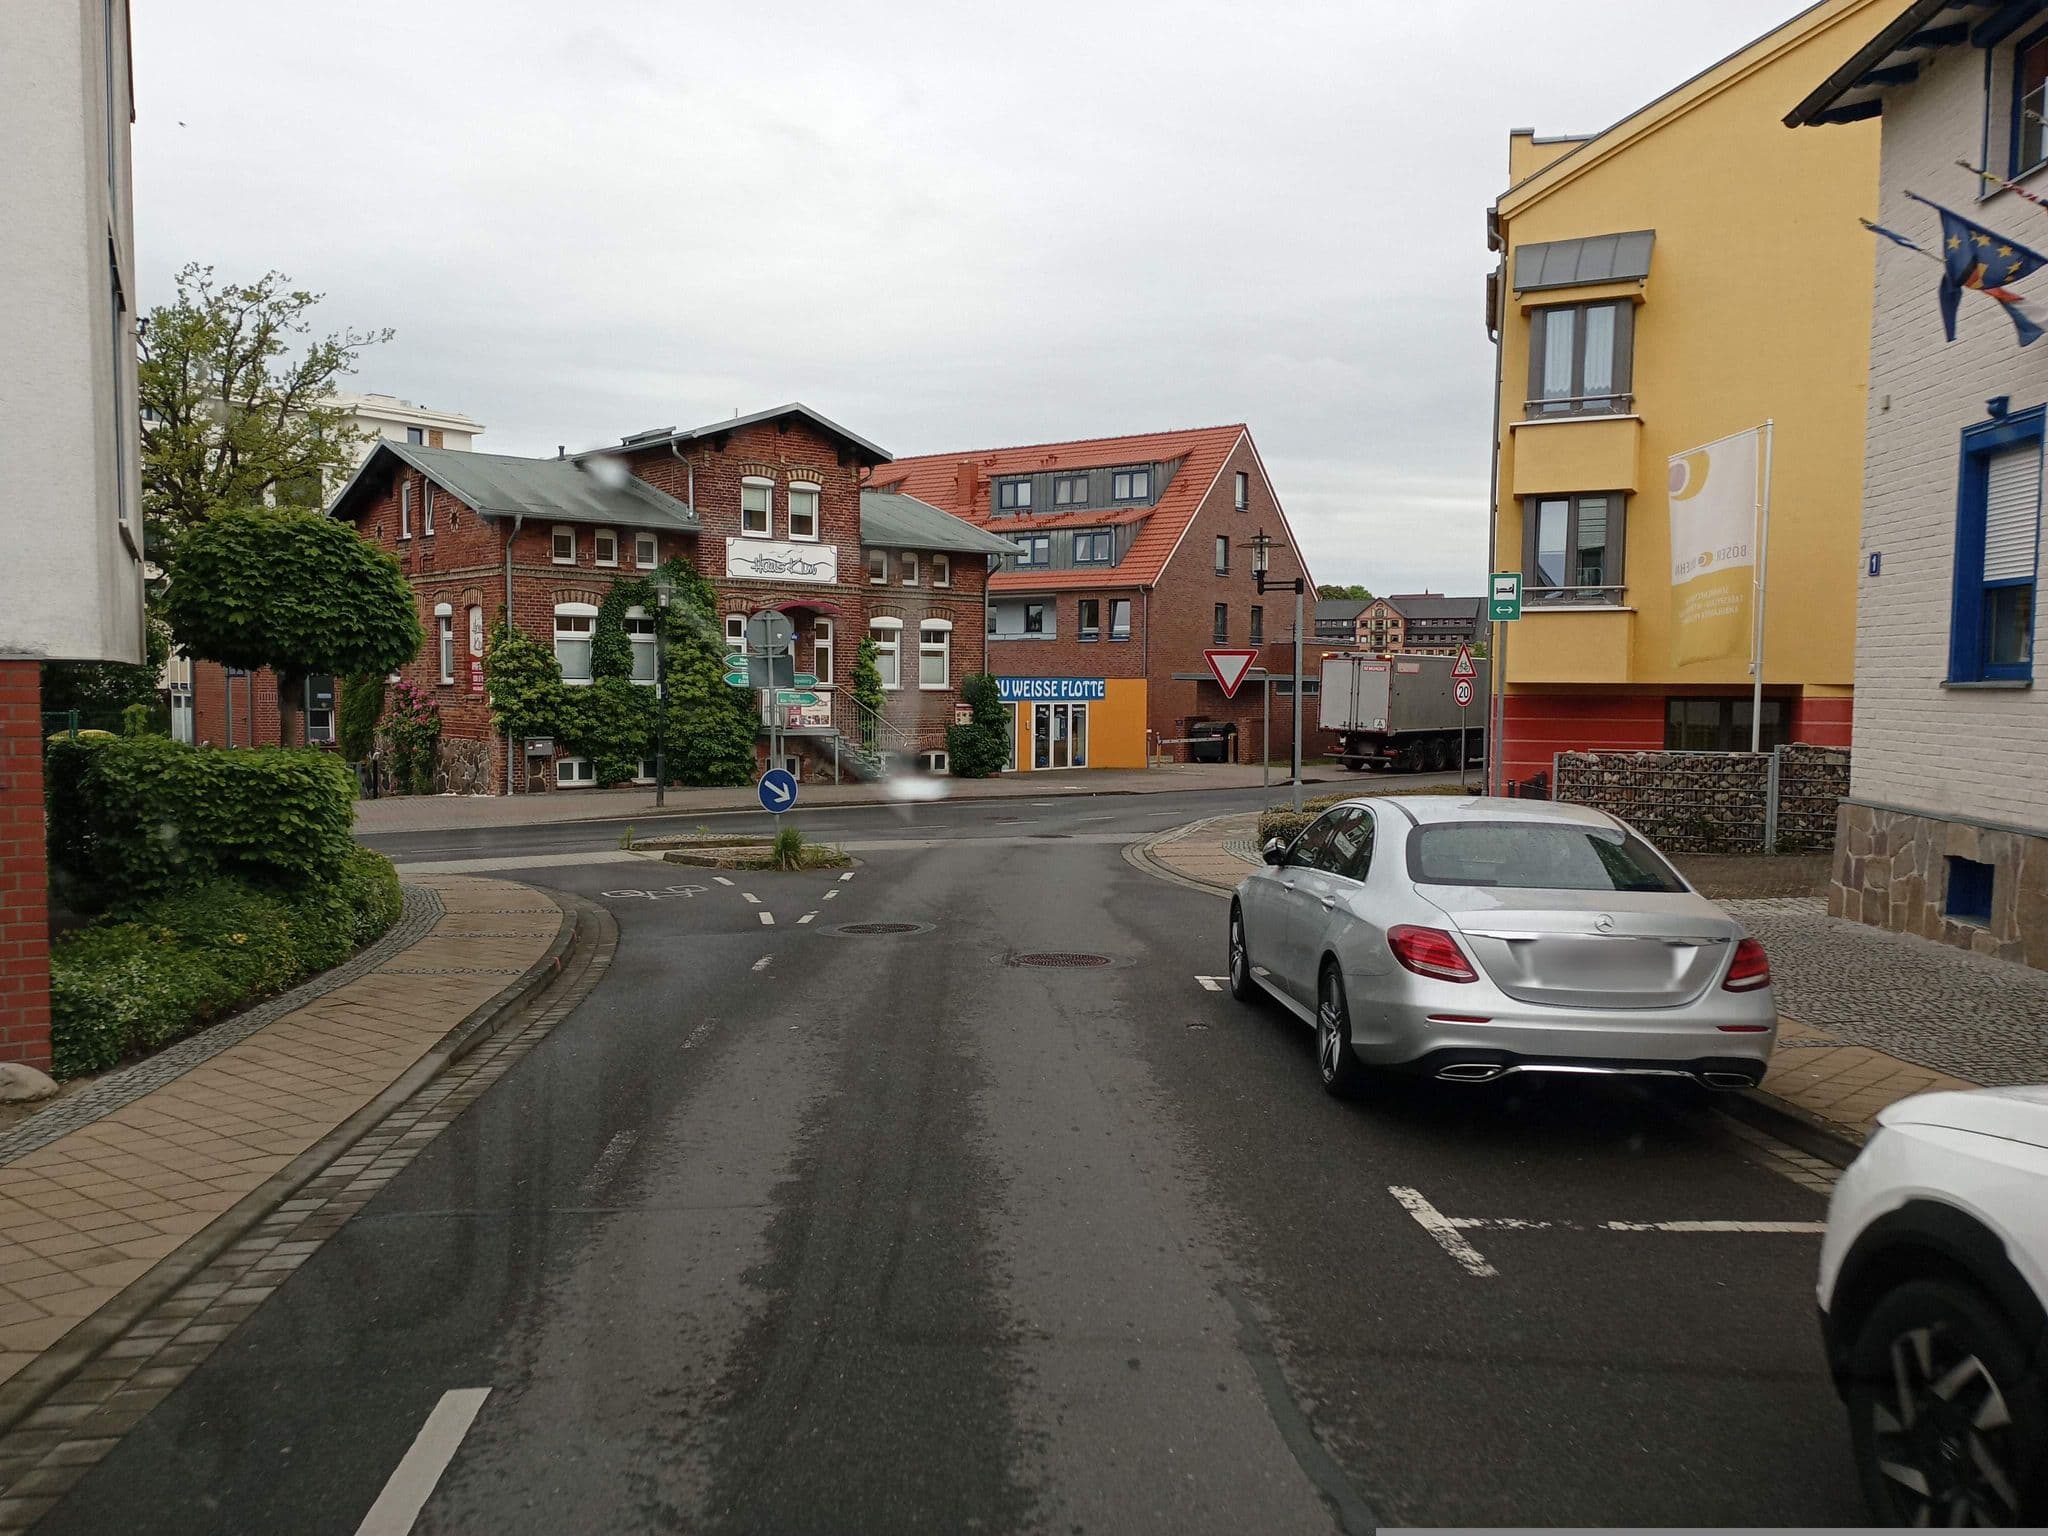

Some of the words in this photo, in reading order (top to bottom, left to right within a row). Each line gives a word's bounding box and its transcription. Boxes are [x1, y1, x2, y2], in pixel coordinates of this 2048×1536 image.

[750, 553, 785, 574] Haus
[1012, 680, 1058, 697] WEISSE
[1061, 680, 1105, 697] FLOTTE
[1458, 686, 1469, 698] 20
